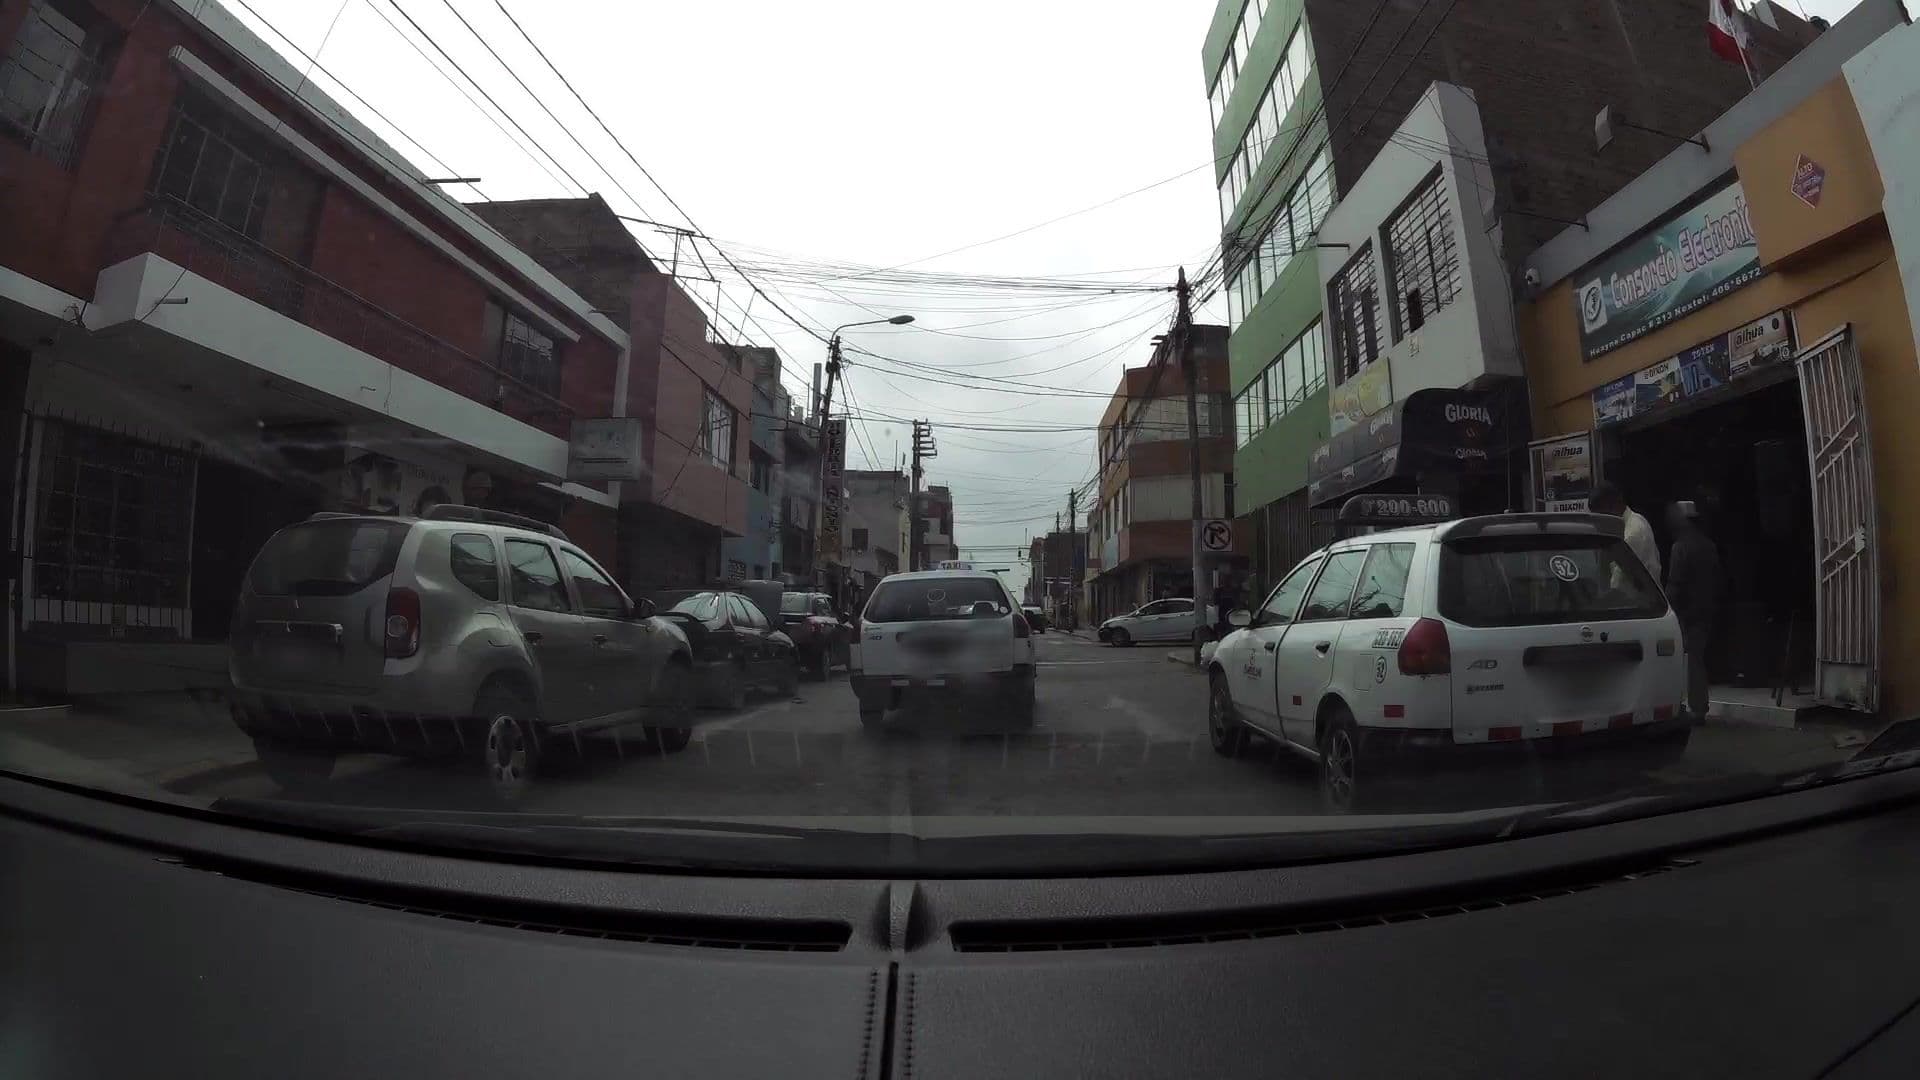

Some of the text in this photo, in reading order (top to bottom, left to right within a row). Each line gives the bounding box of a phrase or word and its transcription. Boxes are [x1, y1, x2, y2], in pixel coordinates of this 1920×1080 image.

[1609, 245, 1677, 308] Consorcio
[1444, 403, 1492, 425] GLORIA
[1554, 559, 1575, 576] 52
[1466, 659, 1498, 670] AD
